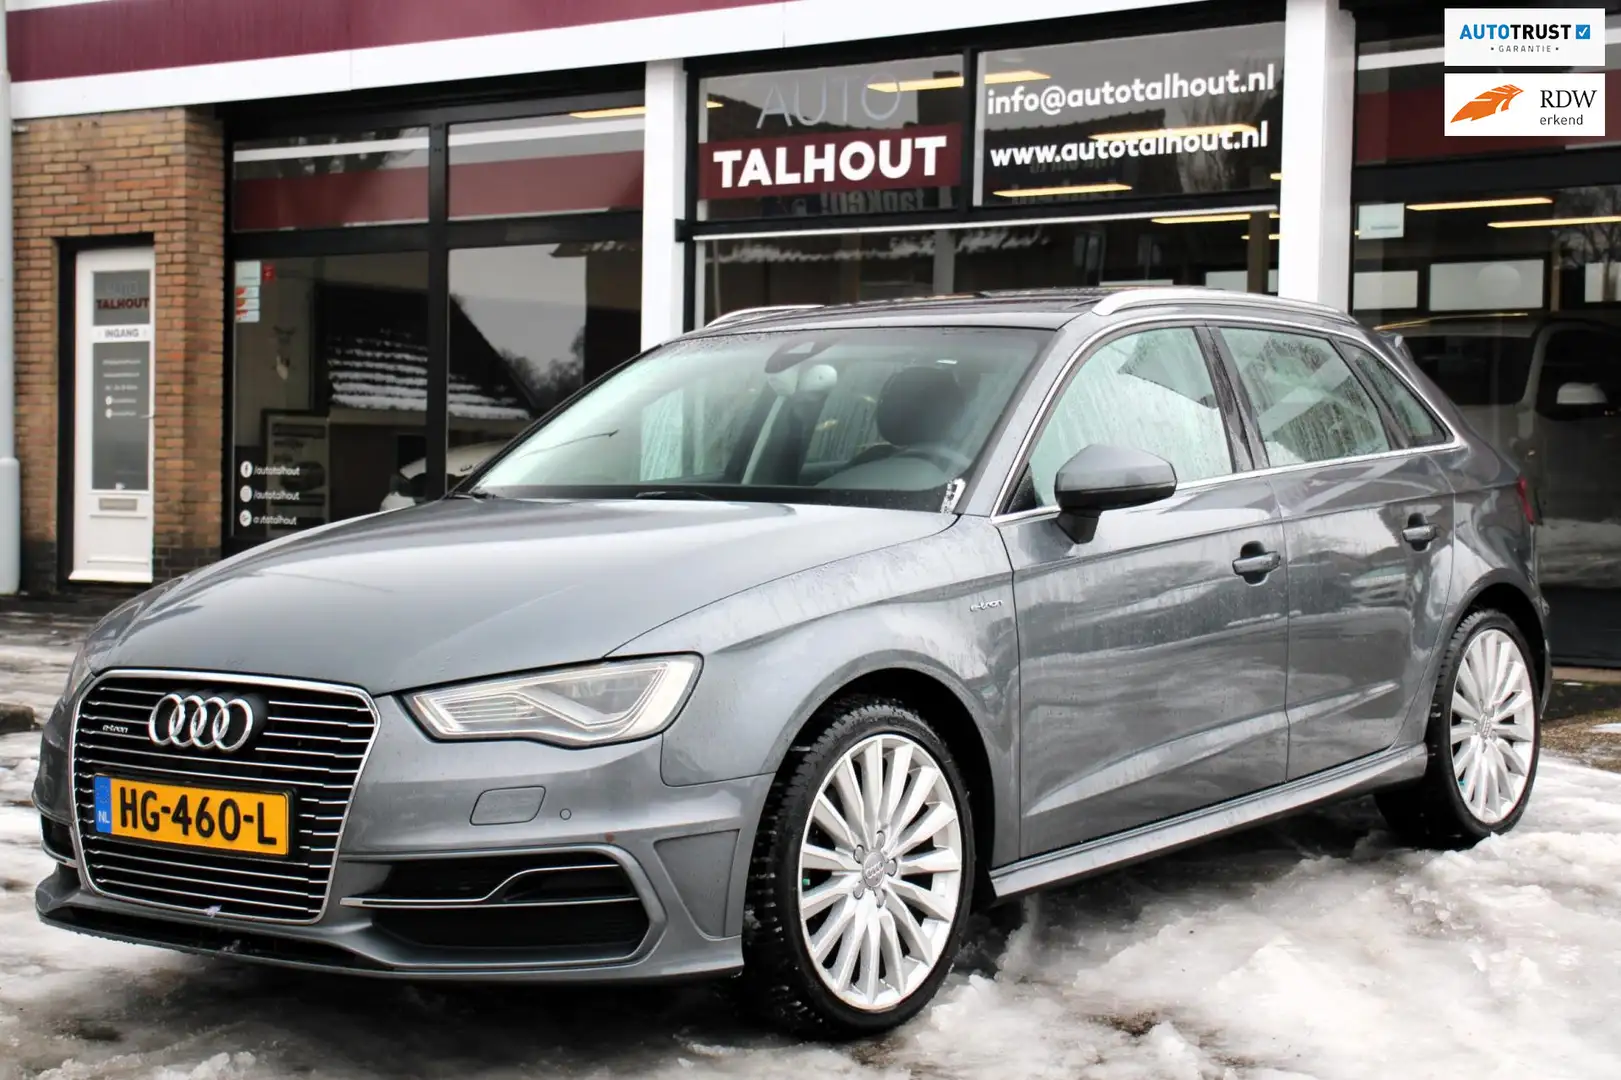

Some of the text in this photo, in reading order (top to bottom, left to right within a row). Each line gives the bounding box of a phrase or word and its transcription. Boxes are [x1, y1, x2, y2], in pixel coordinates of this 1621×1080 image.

[755, 71, 902, 130] AUTO
[987, 64, 1275, 116] info@autotalhout.nl
[712, 135, 947, 189] TALHOUT
[990, 120, 1269, 167] www.autotalhout.nl
[96, 297, 150, 310] TALHOUT
[104, 328, 139, 338] INGANG
[97, 809, 111, 825] NL
[119, 786, 277, 846] HG-460-L
